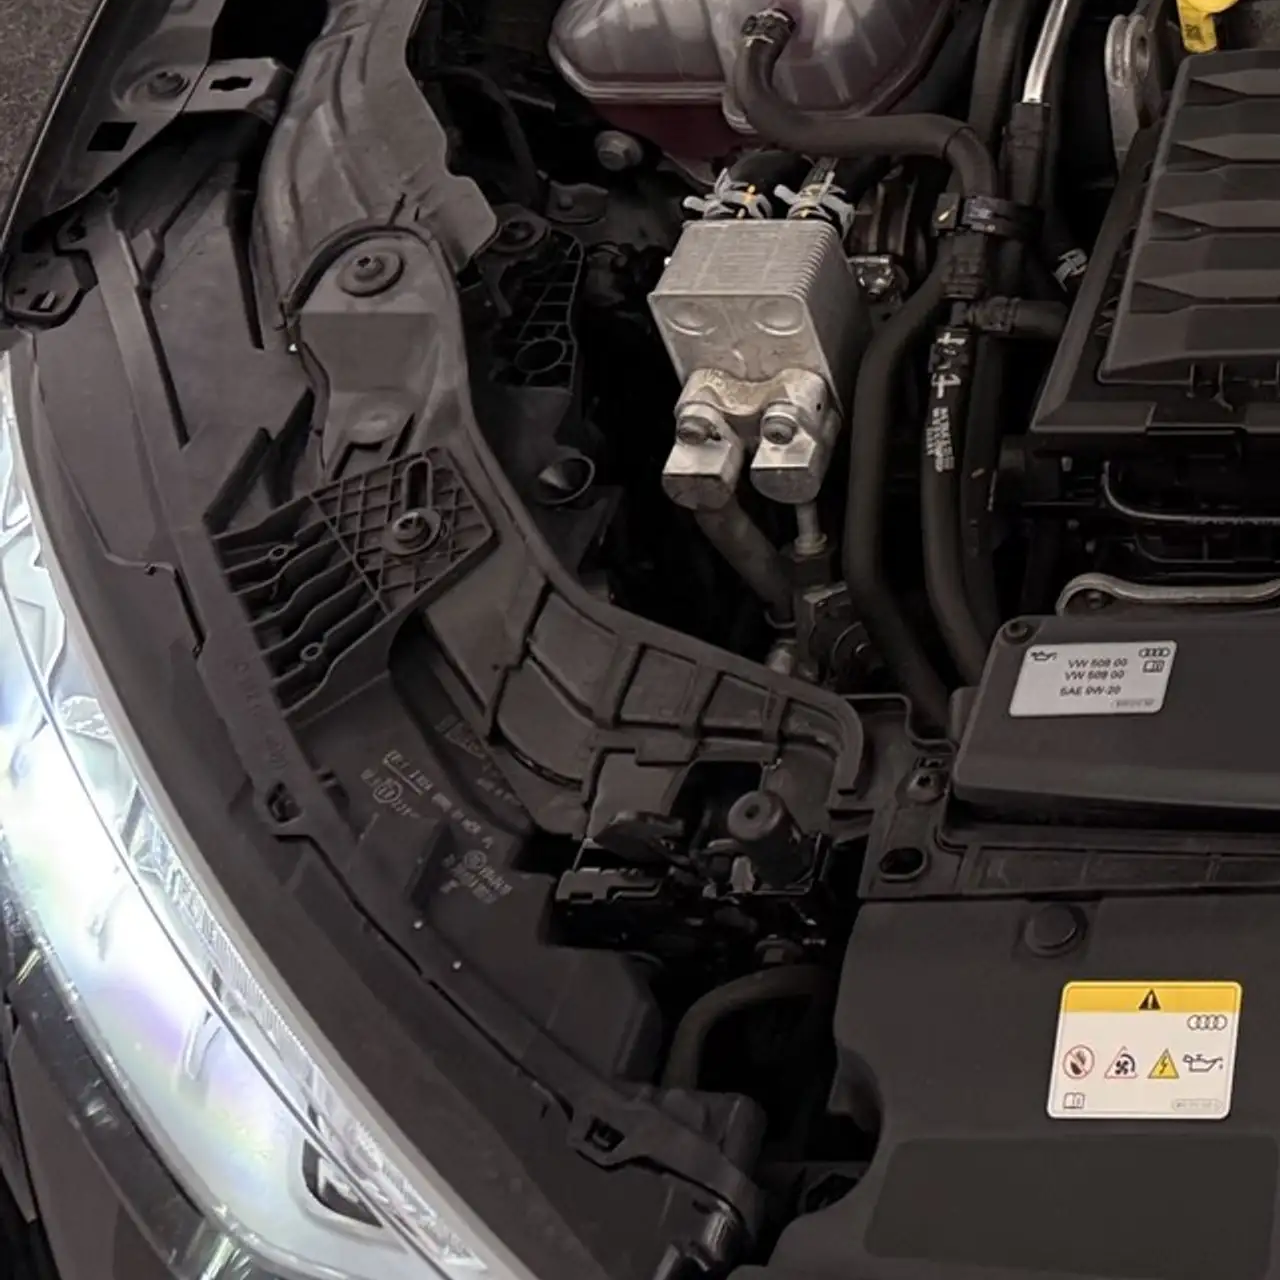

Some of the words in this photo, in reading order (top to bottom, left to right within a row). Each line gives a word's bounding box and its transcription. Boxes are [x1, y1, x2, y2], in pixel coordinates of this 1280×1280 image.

[1067, 659, 1089, 669] VW
[1064, 670, 1086, 681] VW
[1060, 686, 1083, 697] SAE
